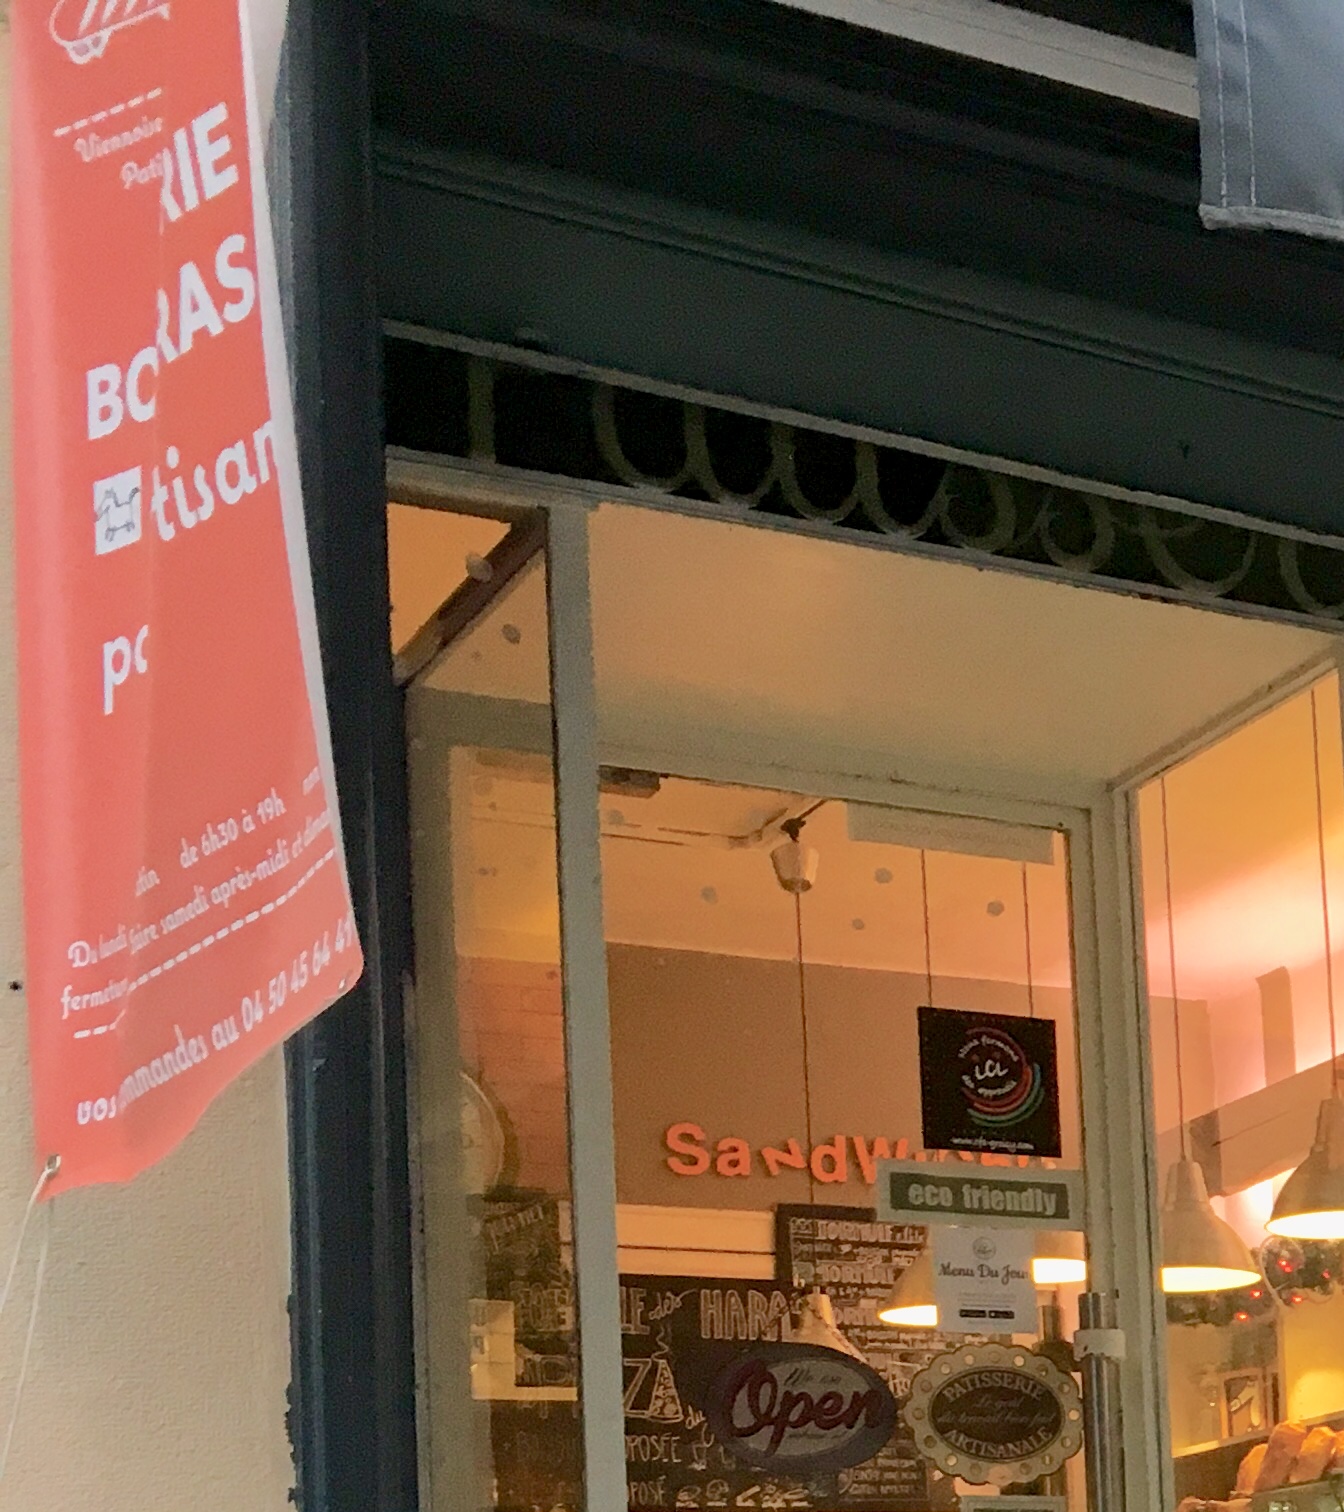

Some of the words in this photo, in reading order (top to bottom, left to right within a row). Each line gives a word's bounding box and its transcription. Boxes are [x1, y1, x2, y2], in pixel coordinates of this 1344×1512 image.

[210, 1015, 241, 1052] au
[240, 989, 265, 1033] 04
[907, 1183, 954, 1207] eco
[961, 1183, 1058, 1217] friendly
[937, 1260, 976, 1278] Menu
[977, 1263, 1000, 1278] Du
[942, 1371, 1047, 1404] PATISSERIE
[727, 1359, 886, 1458] Open
[943, 1425, 1055, 1459] ARTISANALE
